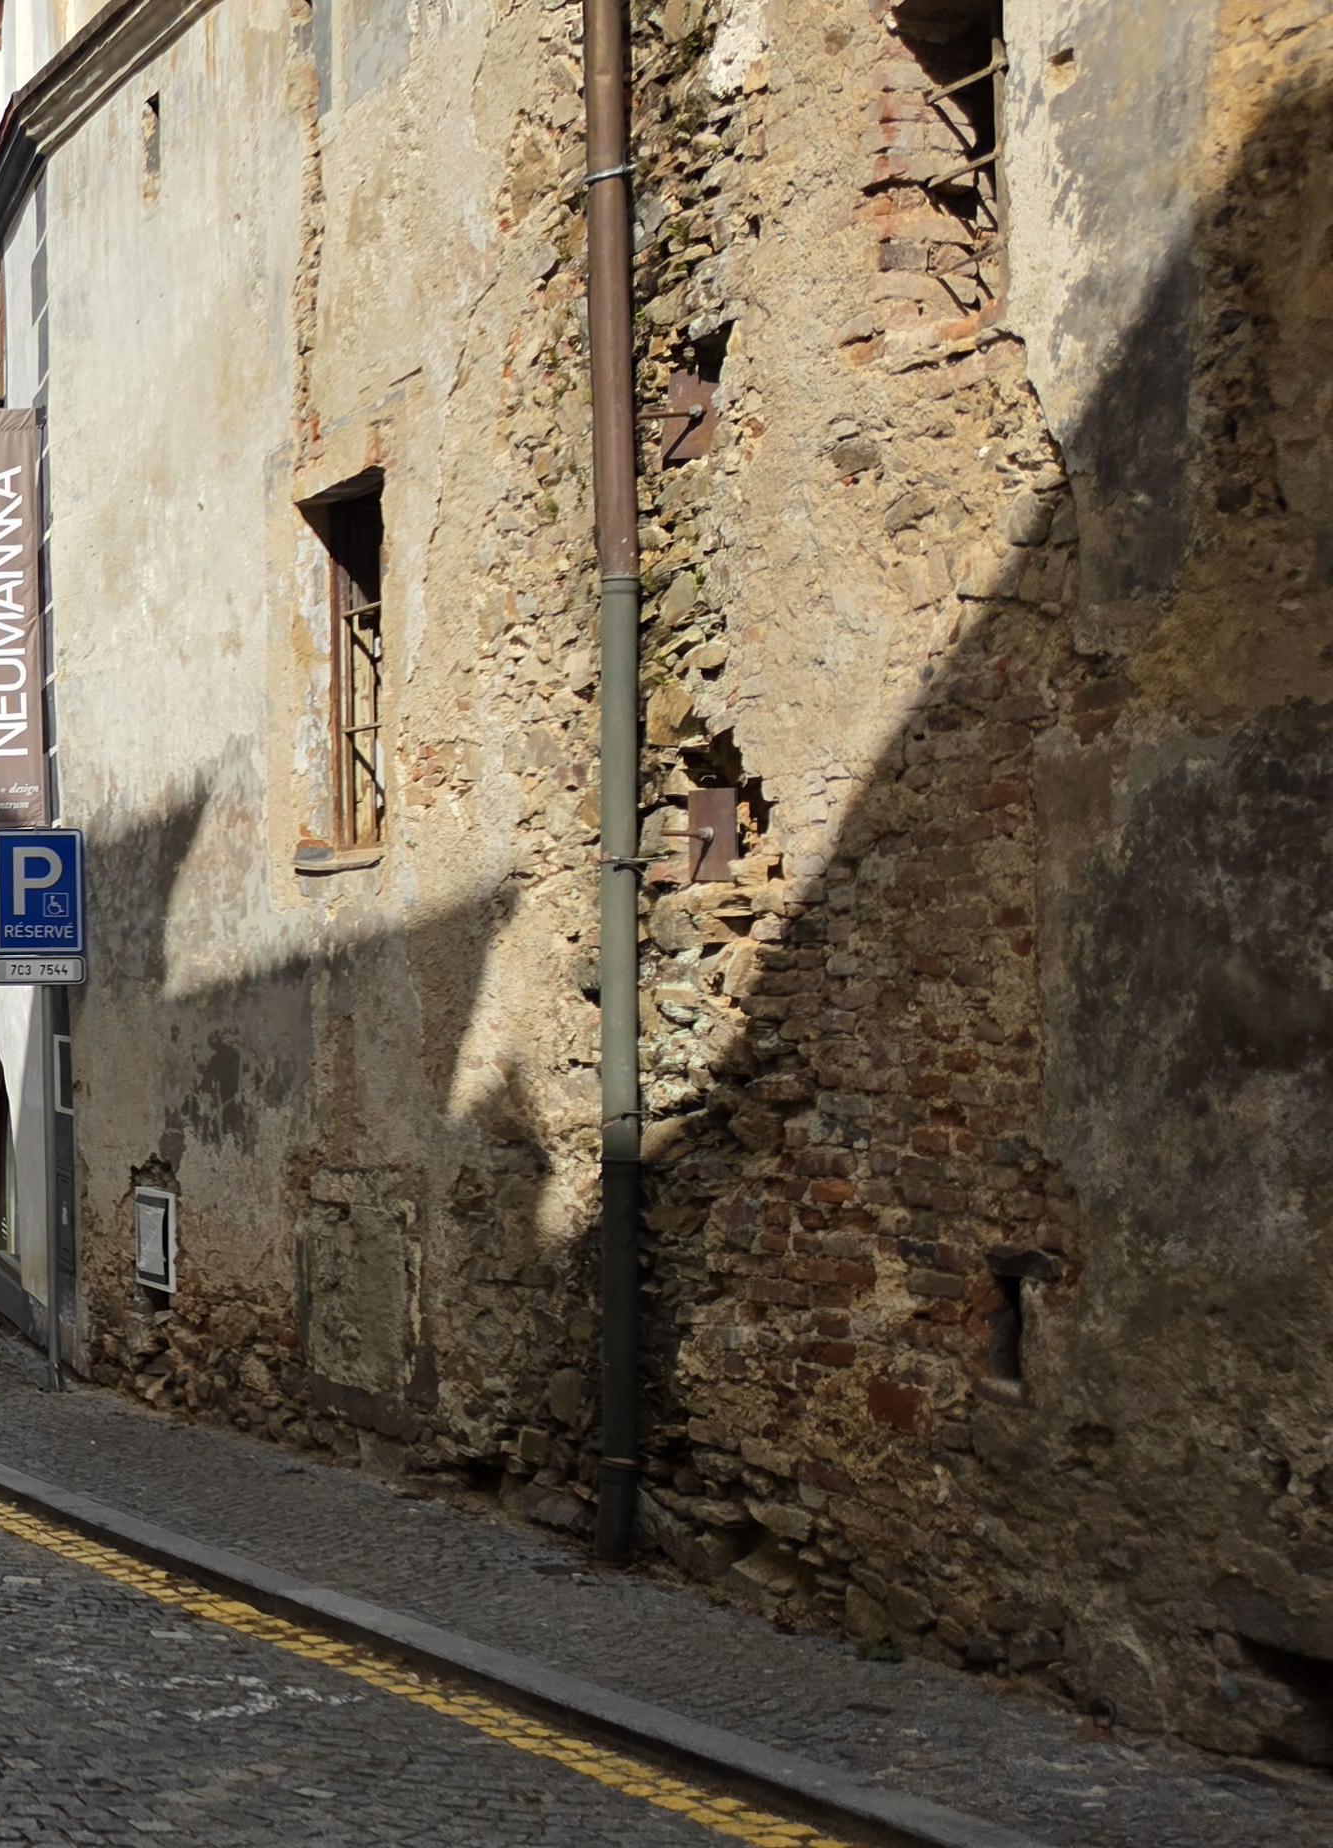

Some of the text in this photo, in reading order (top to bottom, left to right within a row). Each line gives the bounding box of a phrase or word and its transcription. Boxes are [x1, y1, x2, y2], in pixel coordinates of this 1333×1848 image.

[8, 782, 40, 796] design
[12, 846, 63, 916] P
[4, 922, 74, 939] RÉSERVÉ
[39, 964, 68, 976] 7544
